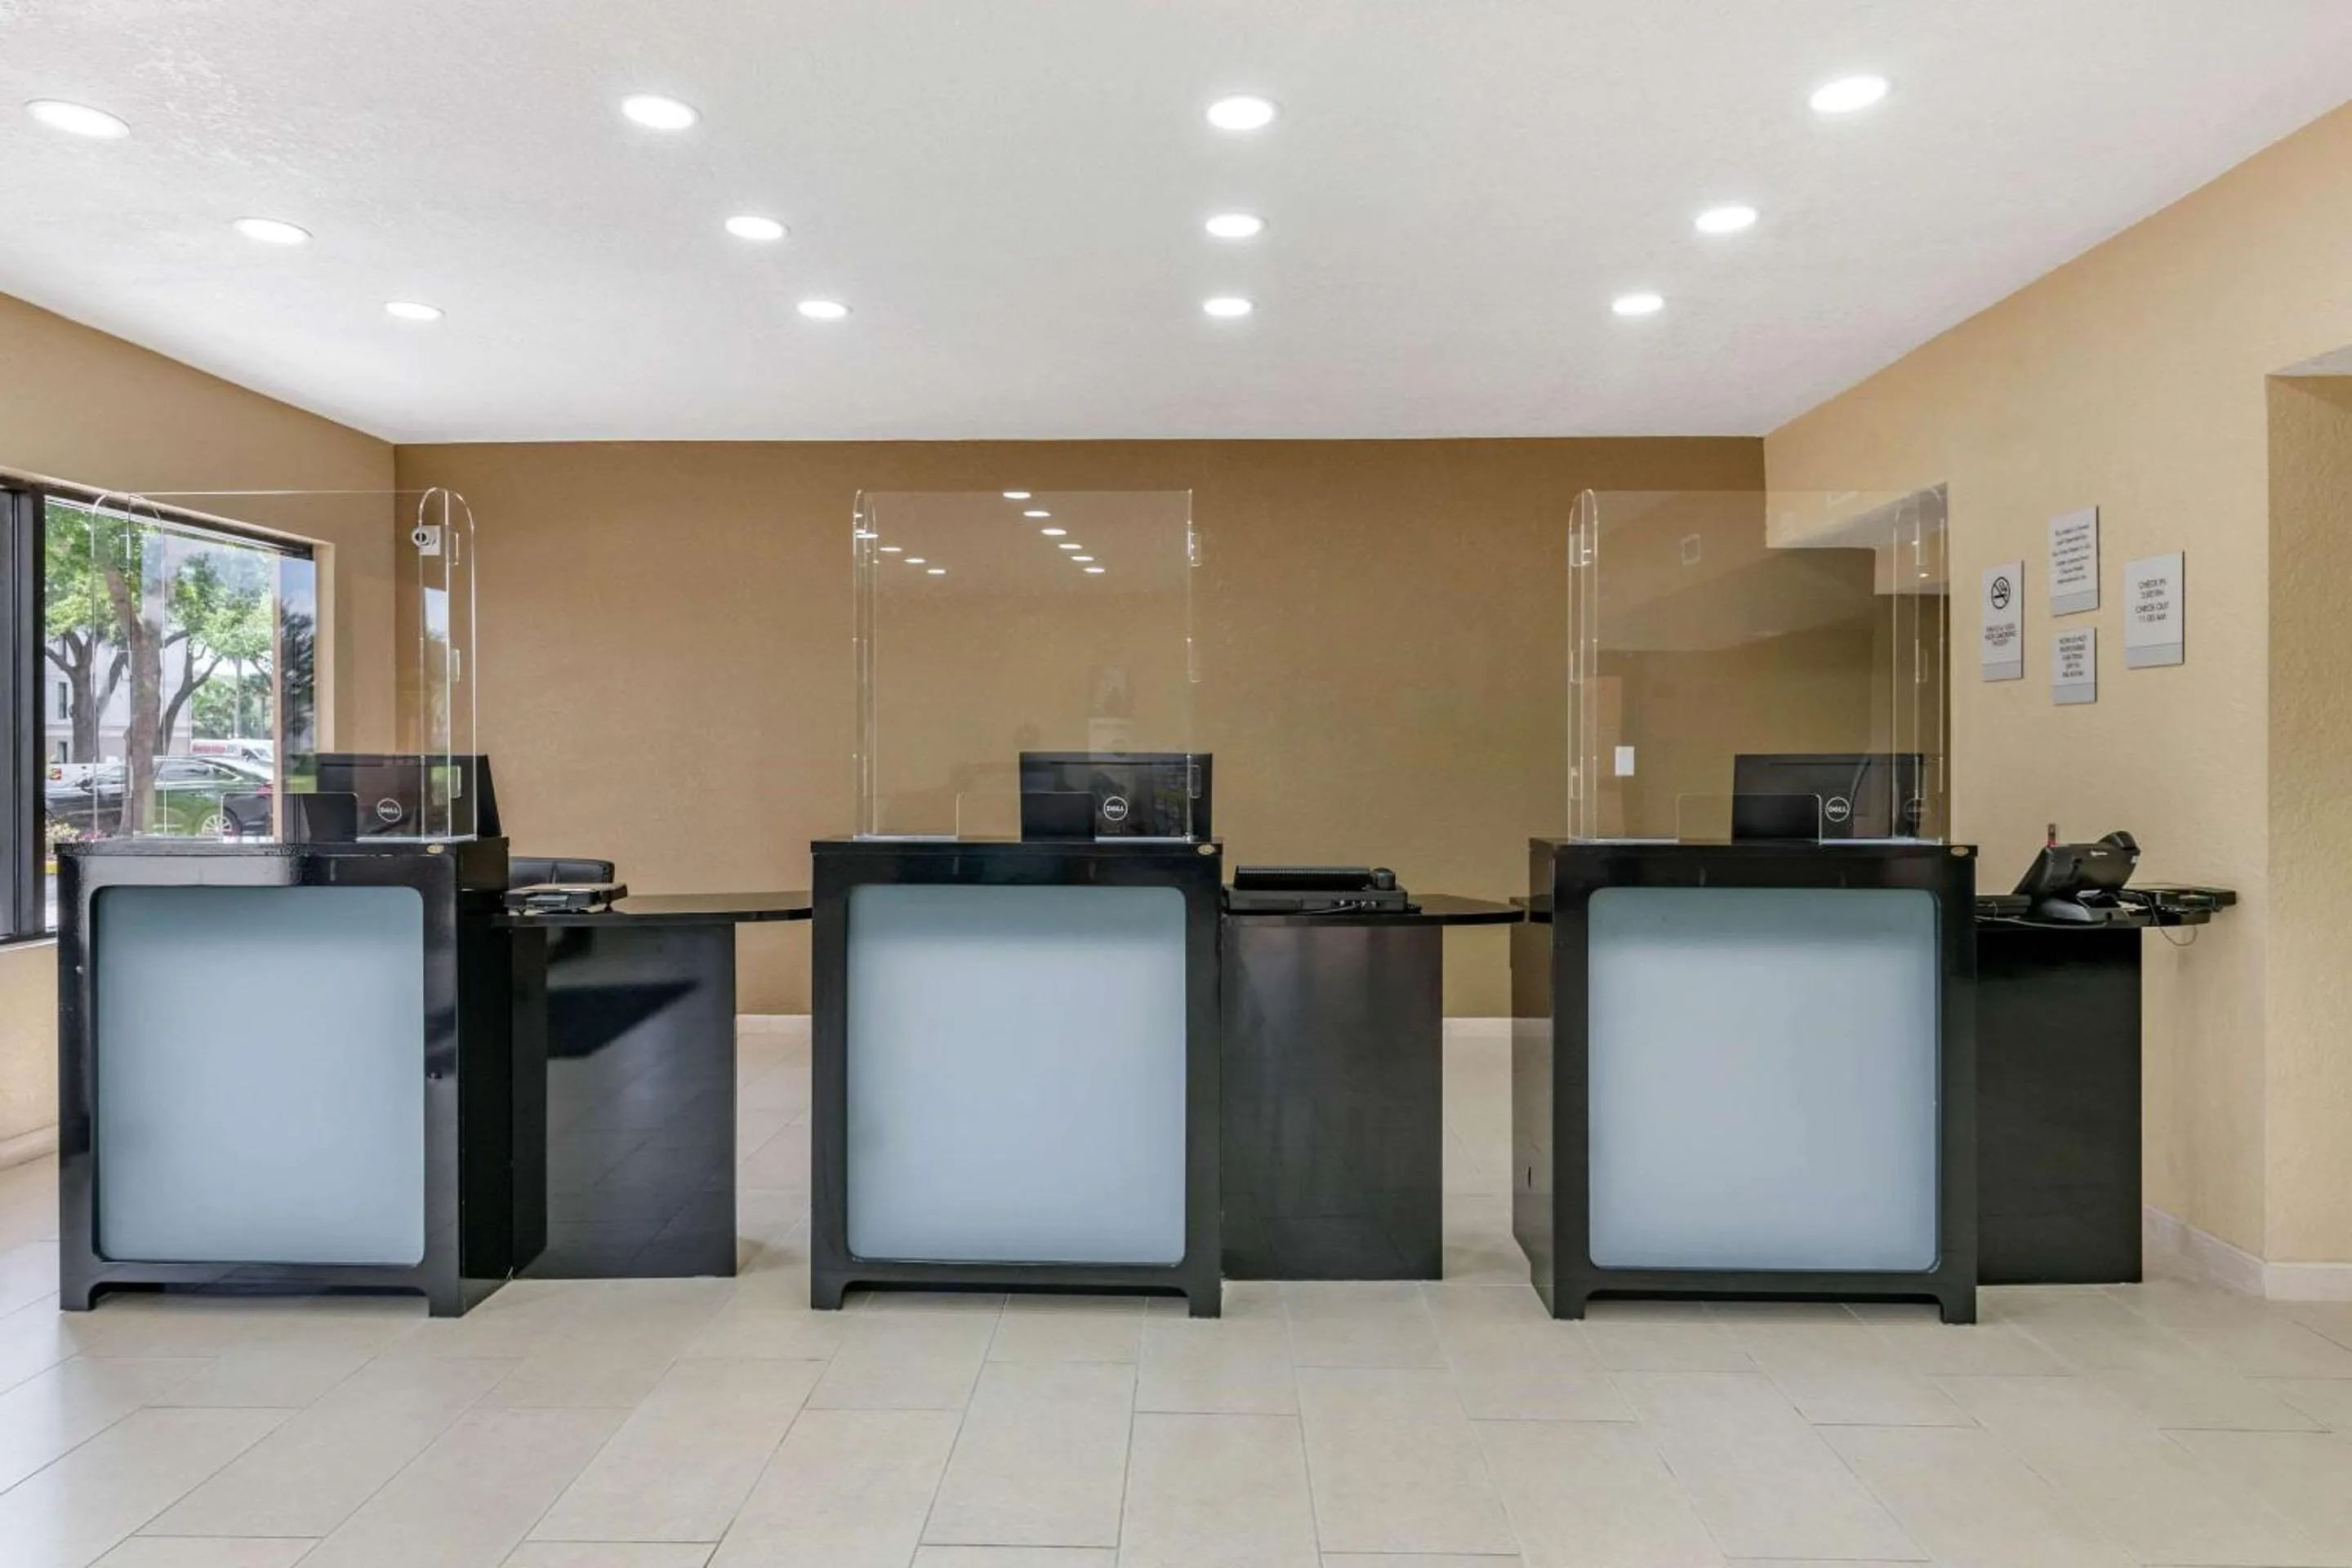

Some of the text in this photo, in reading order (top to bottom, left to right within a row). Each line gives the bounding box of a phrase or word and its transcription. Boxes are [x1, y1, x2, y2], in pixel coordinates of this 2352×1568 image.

[380, 805, 399, 814] DELL
[1106, 804, 1125, 813] DELL
[1828, 804, 1846, 813] DELL
